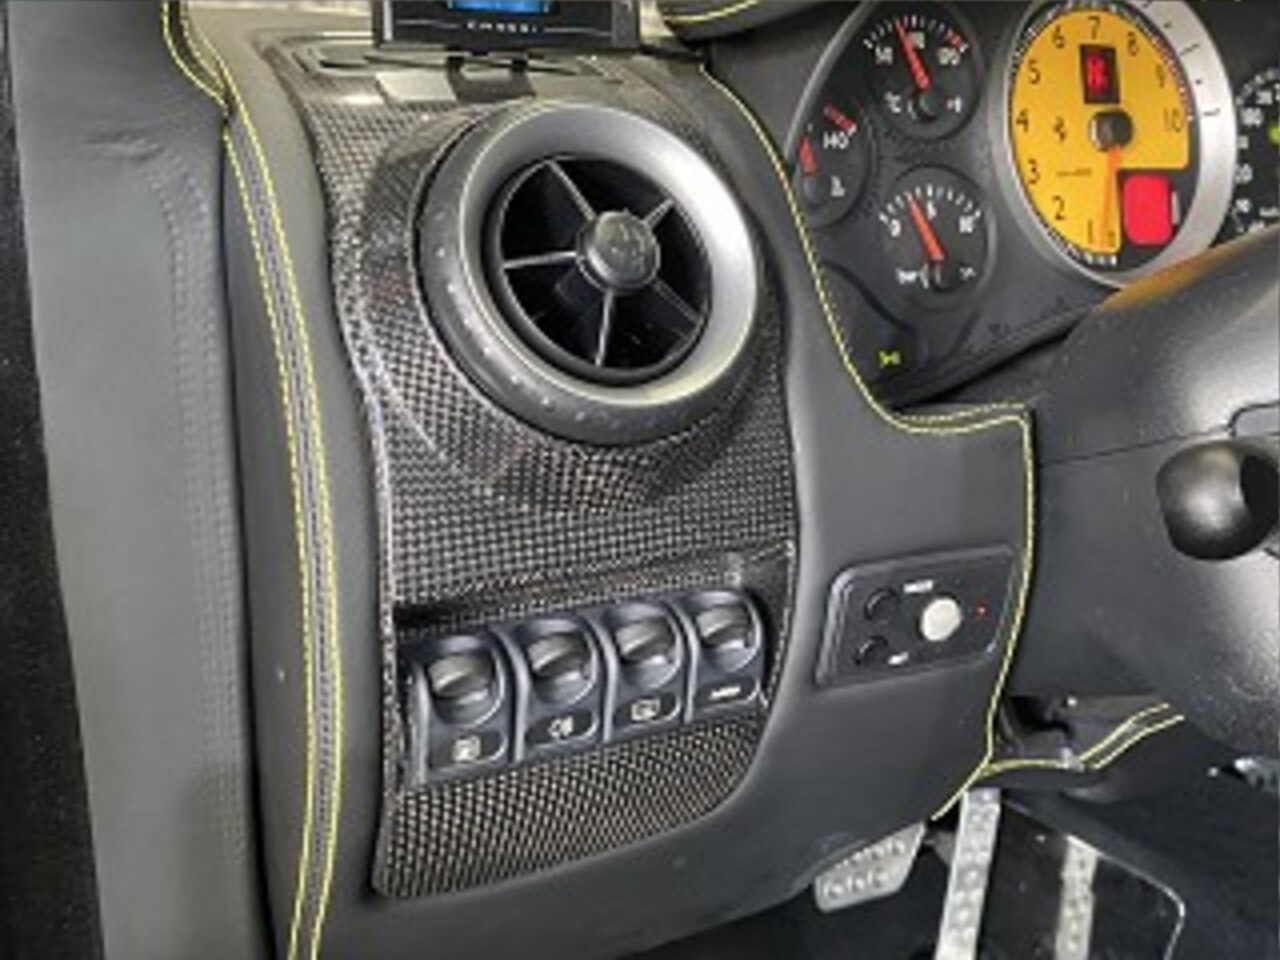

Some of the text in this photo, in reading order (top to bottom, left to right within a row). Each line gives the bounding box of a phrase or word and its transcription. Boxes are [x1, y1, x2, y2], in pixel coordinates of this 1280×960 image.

[1053, 26, 1064, 49] 6
[1088, 16, 1100, 40] 7
[1029, 60, 1040, 84] 5
[1016, 109, 1028, 132] 4
[1029, 160, 1039, 185] 3
[1053, 197, 1065, 220] 2
